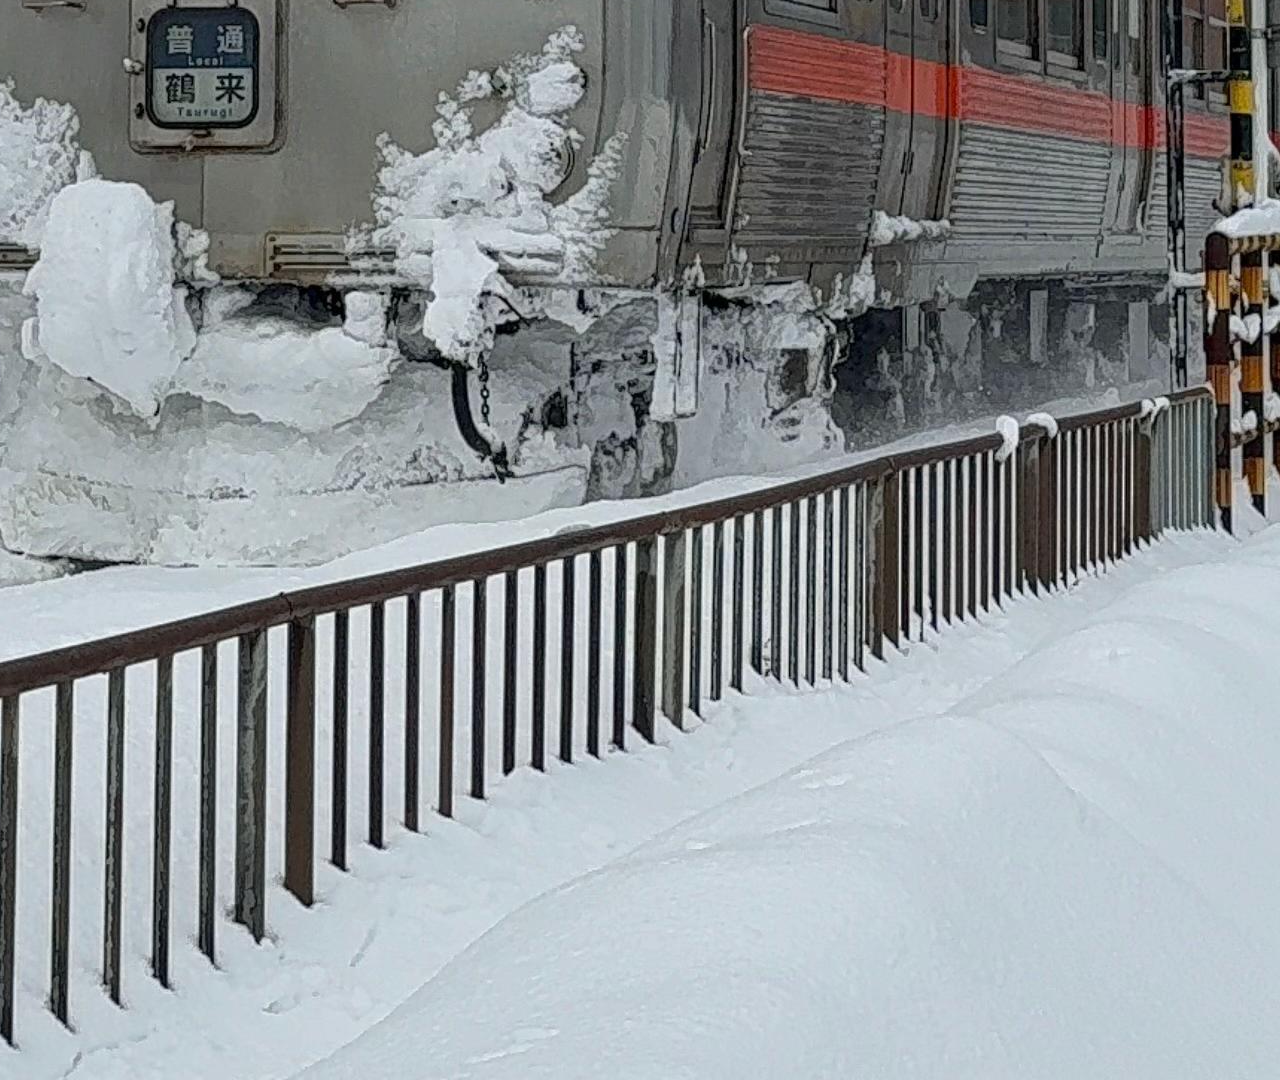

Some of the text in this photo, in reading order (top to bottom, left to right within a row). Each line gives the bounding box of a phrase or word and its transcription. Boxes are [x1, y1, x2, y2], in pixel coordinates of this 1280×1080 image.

[166, 25, 244, 54] 普通
[188, 55, 224, 66] Local
[165, 73, 246, 104] 鶴来
[177, 107, 233, 119] Tsurugi
